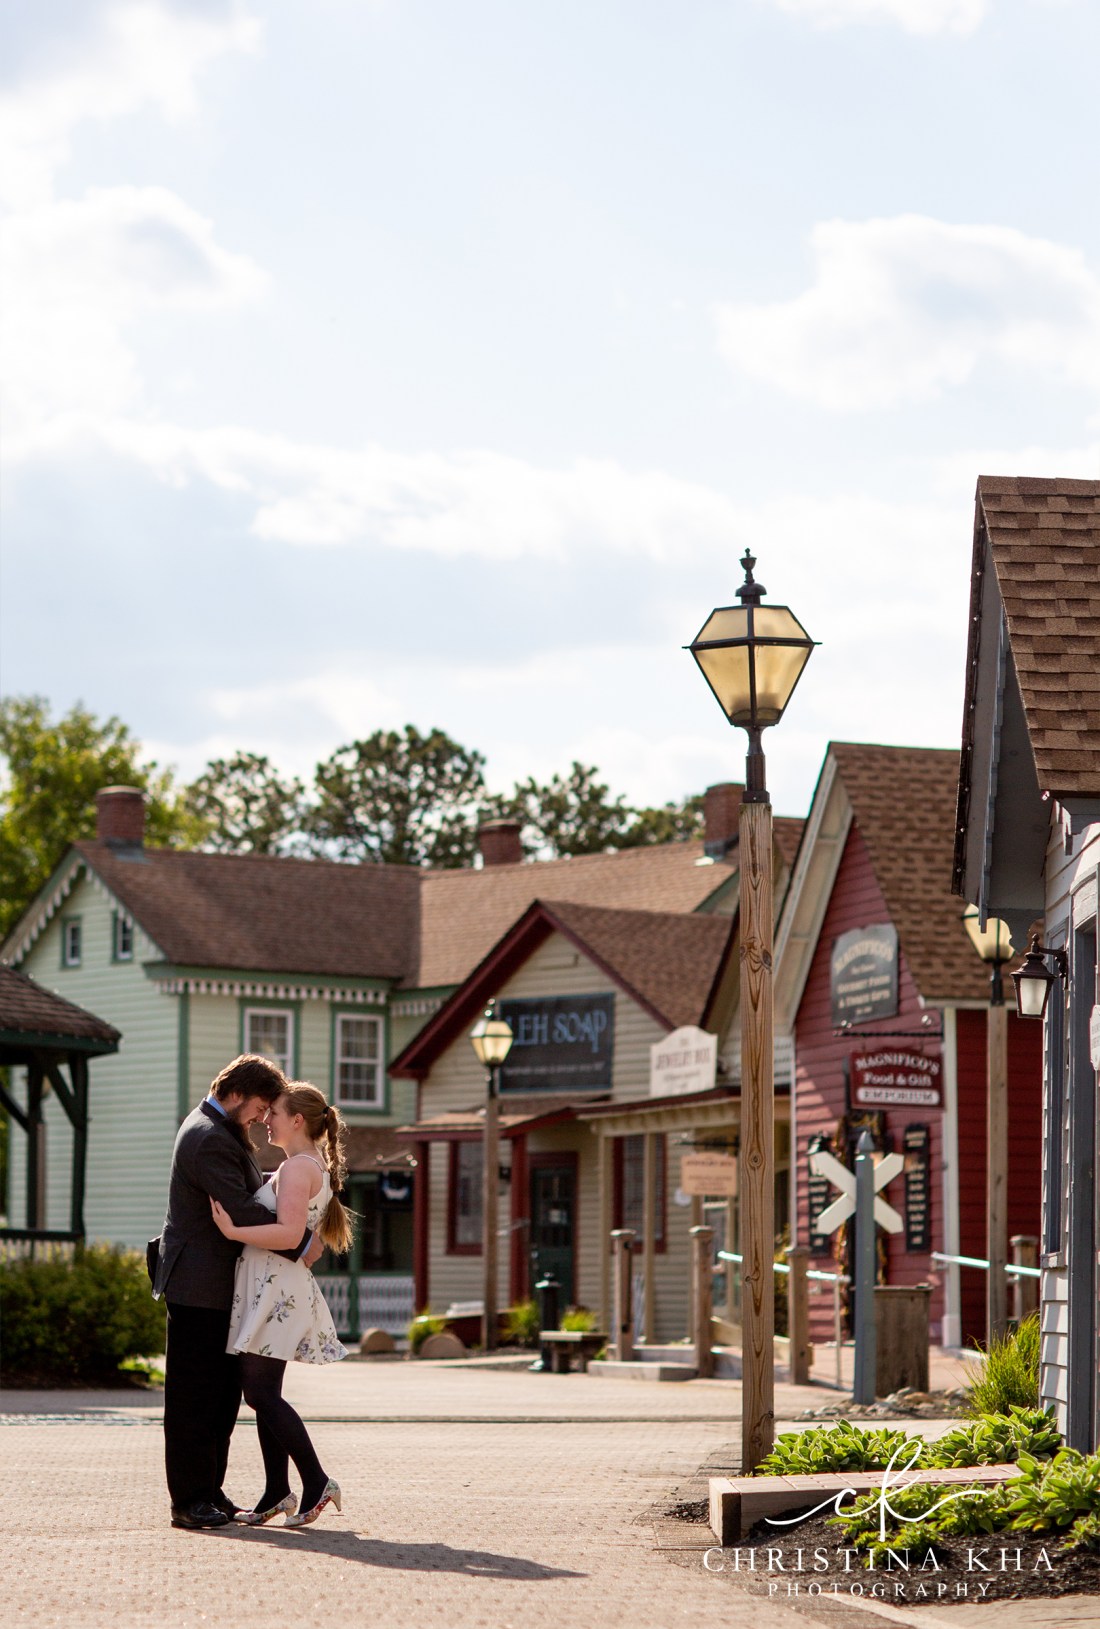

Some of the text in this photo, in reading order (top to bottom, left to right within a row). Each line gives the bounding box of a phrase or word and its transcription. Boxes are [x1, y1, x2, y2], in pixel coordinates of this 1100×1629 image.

[552, 1009, 607, 1053] SOAP
[856, 1053, 939, 1076] MAGNIFICO'S
[864, 1072, 932, 1086] Food & Gift
[863, 1090, 933, 1101] EMPORIUM
